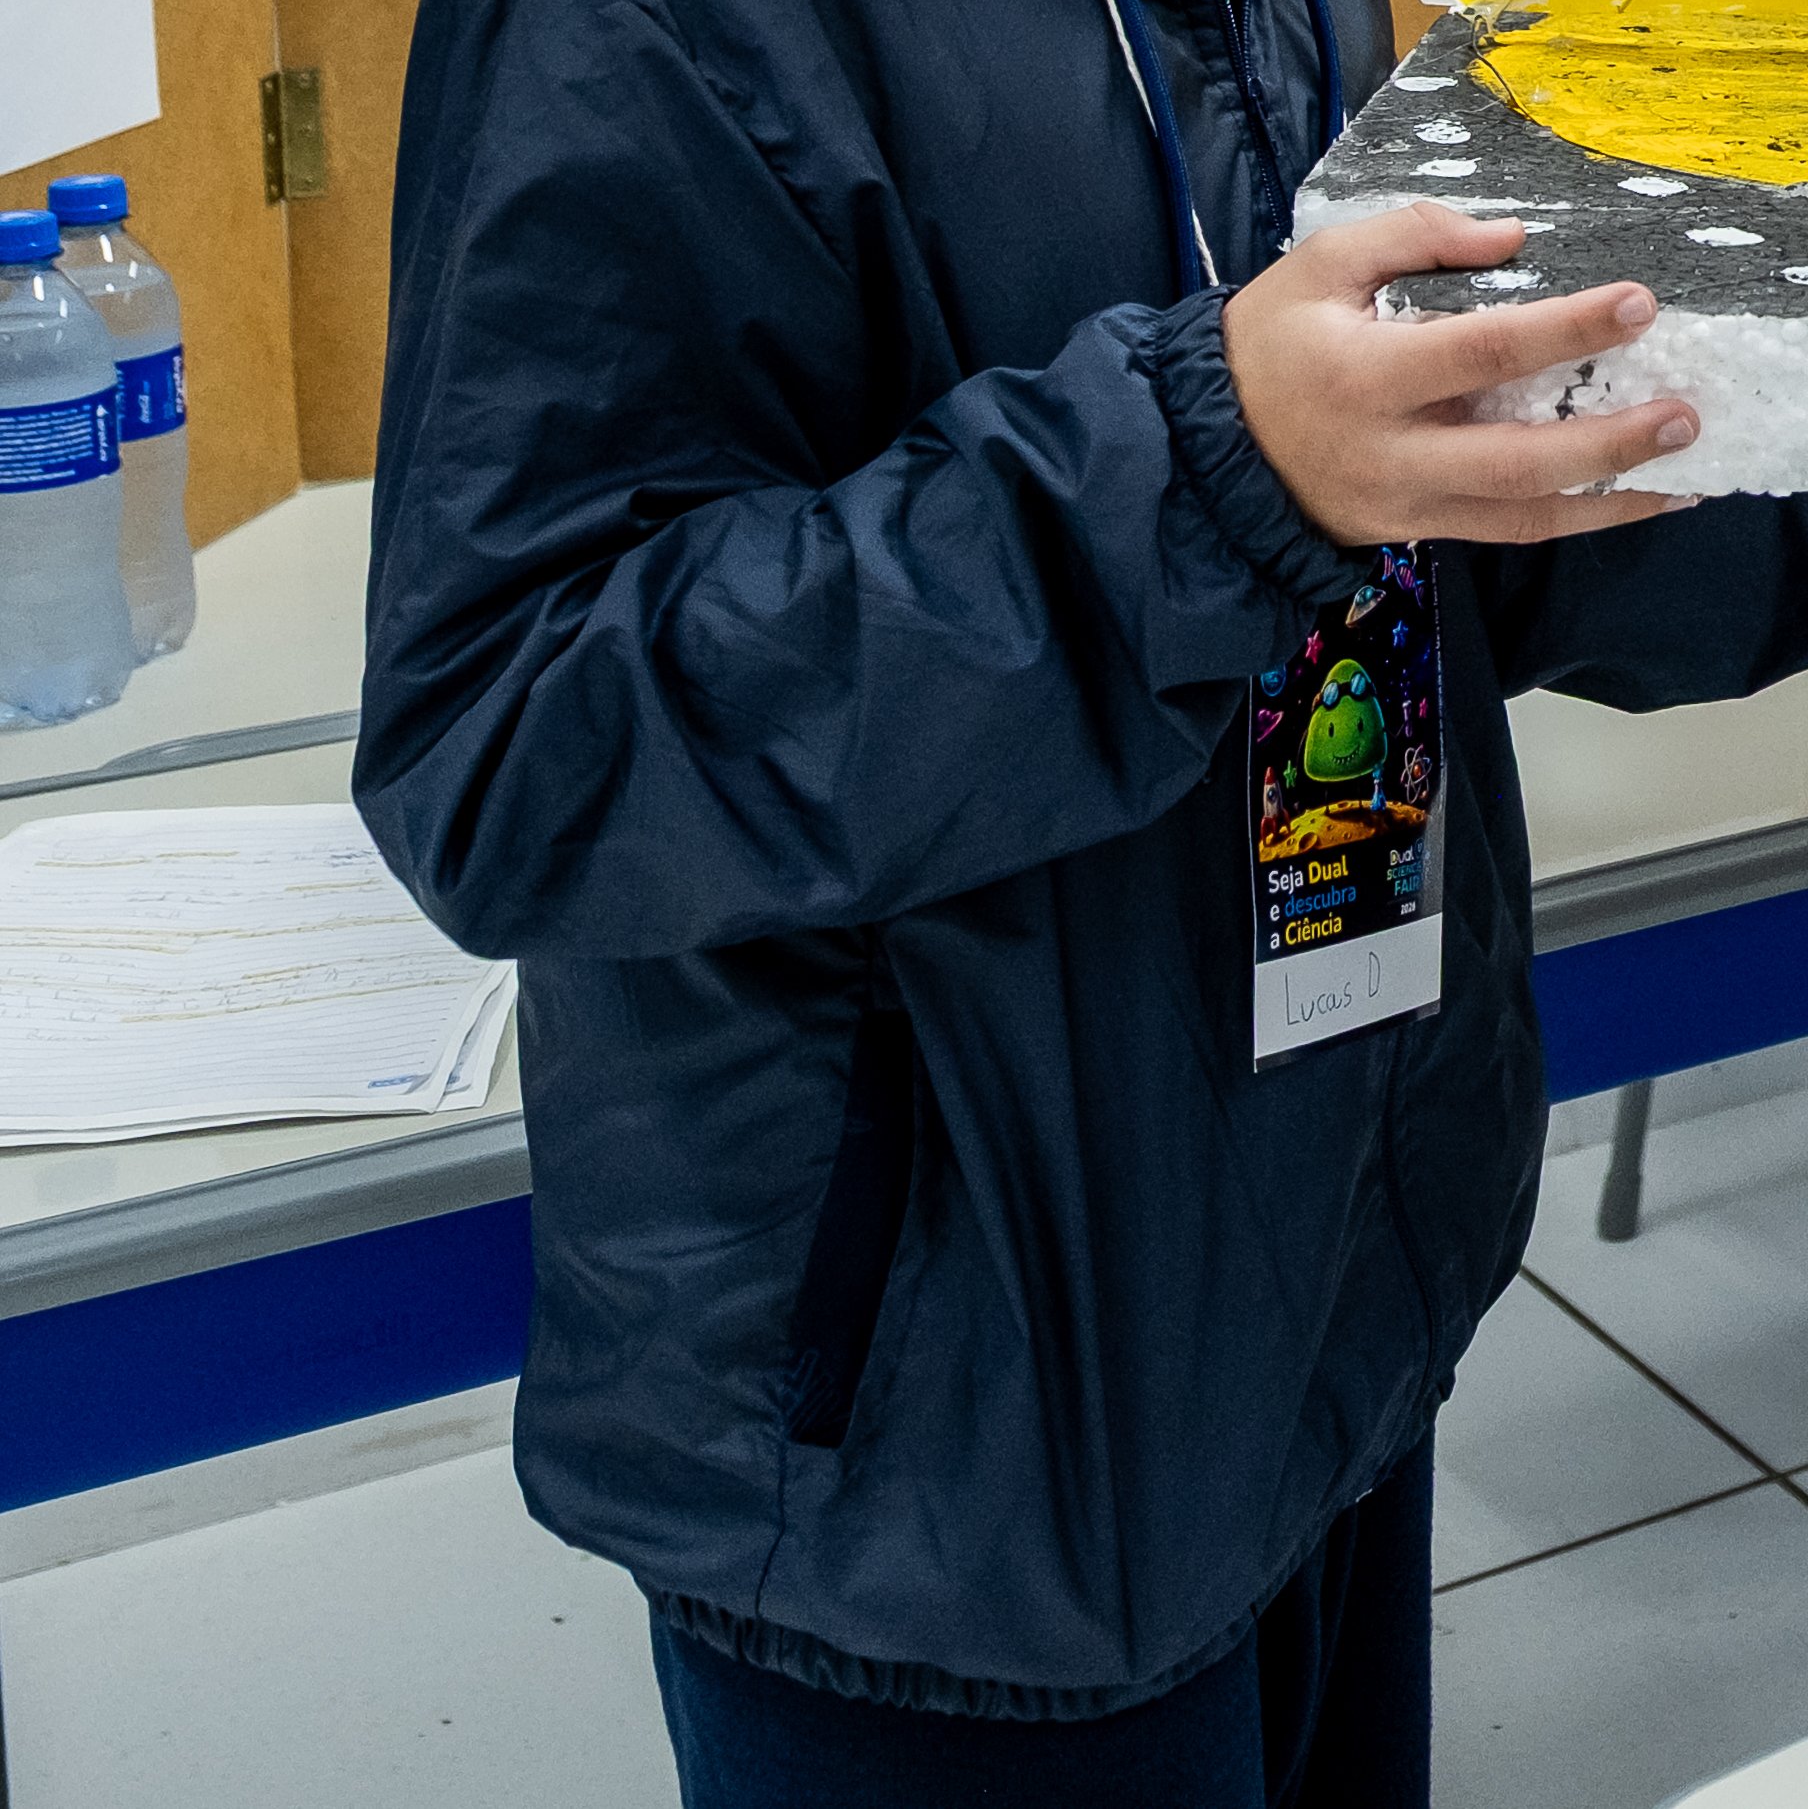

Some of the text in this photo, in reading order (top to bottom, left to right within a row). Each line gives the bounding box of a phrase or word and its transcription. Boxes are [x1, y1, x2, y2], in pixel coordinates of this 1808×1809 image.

[1268, 855, 1349, 894] Seja Dual
[1270, 885, 1356, 921] e descubra
[1270, 912, 1342, 949] a Ciência
[1285, 951, 1381, 1026] Lucas D
